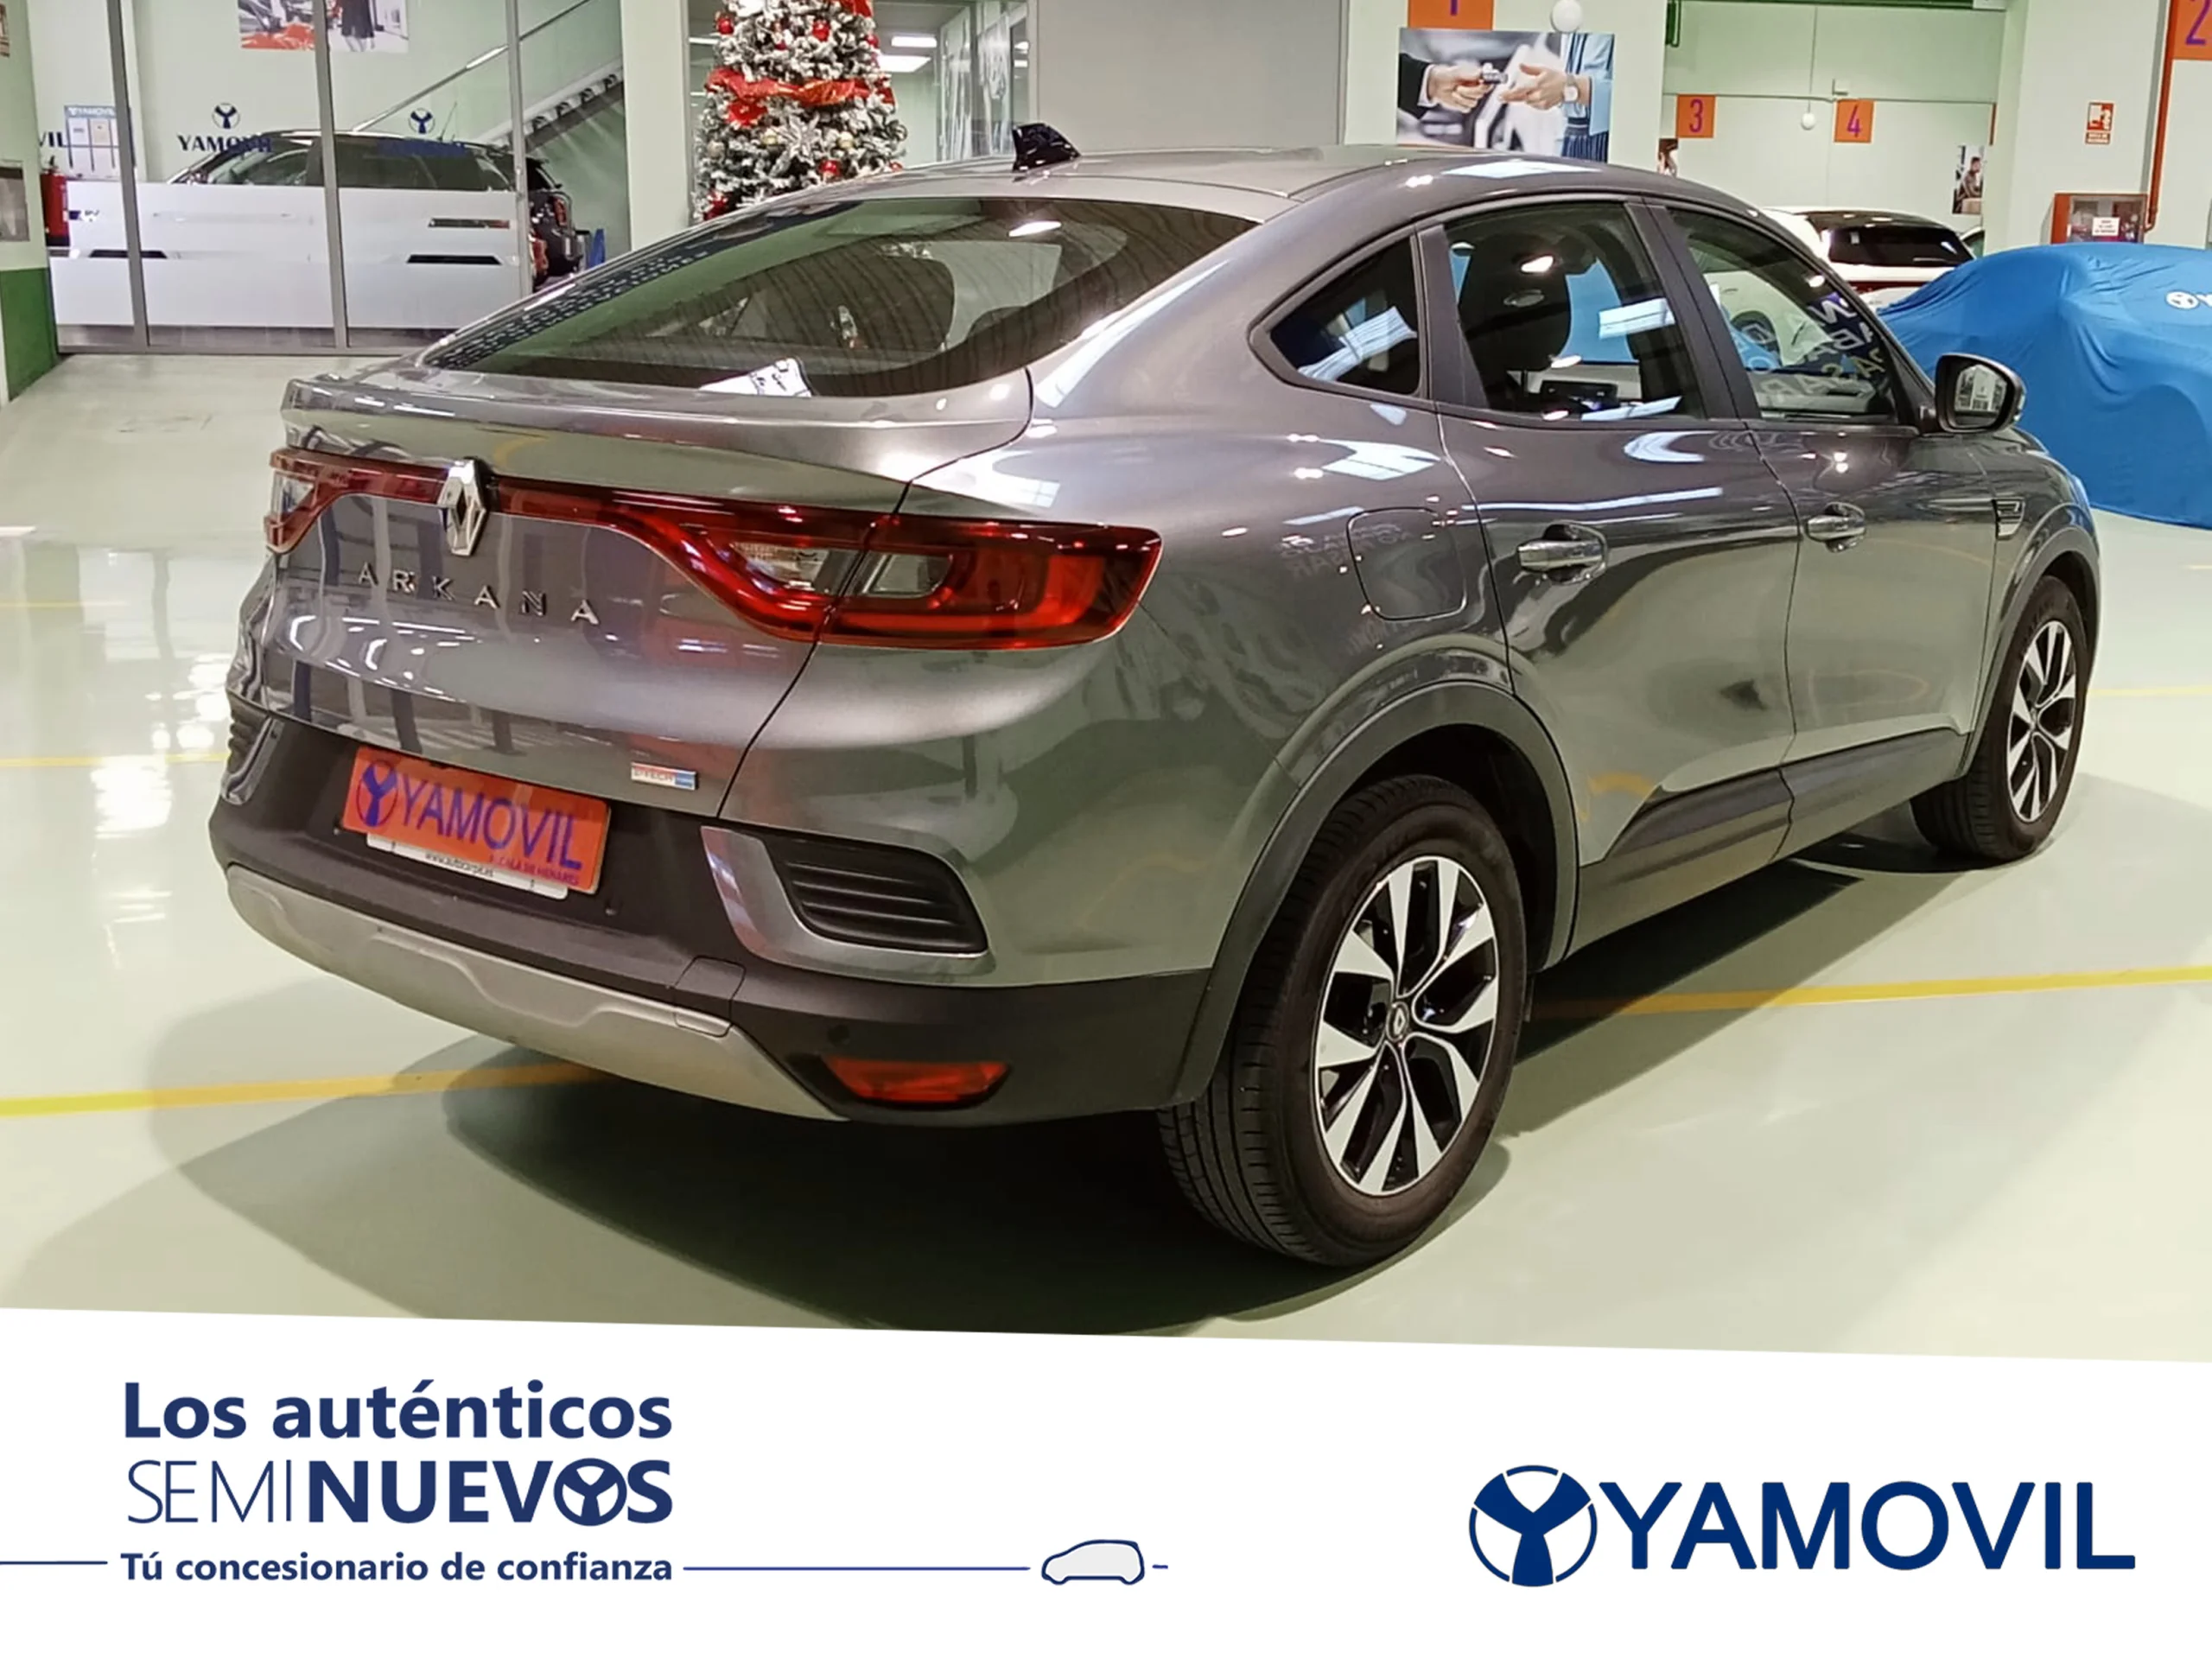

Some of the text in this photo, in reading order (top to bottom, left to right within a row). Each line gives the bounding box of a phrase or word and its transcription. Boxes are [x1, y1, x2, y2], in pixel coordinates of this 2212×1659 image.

[1689, 99, 1704, 133] 3
[1847, 104, 1861, 138] 4
[357, 560, 601, 626] ARKANA
[401, 772, 584, 871] YAMOVIL
